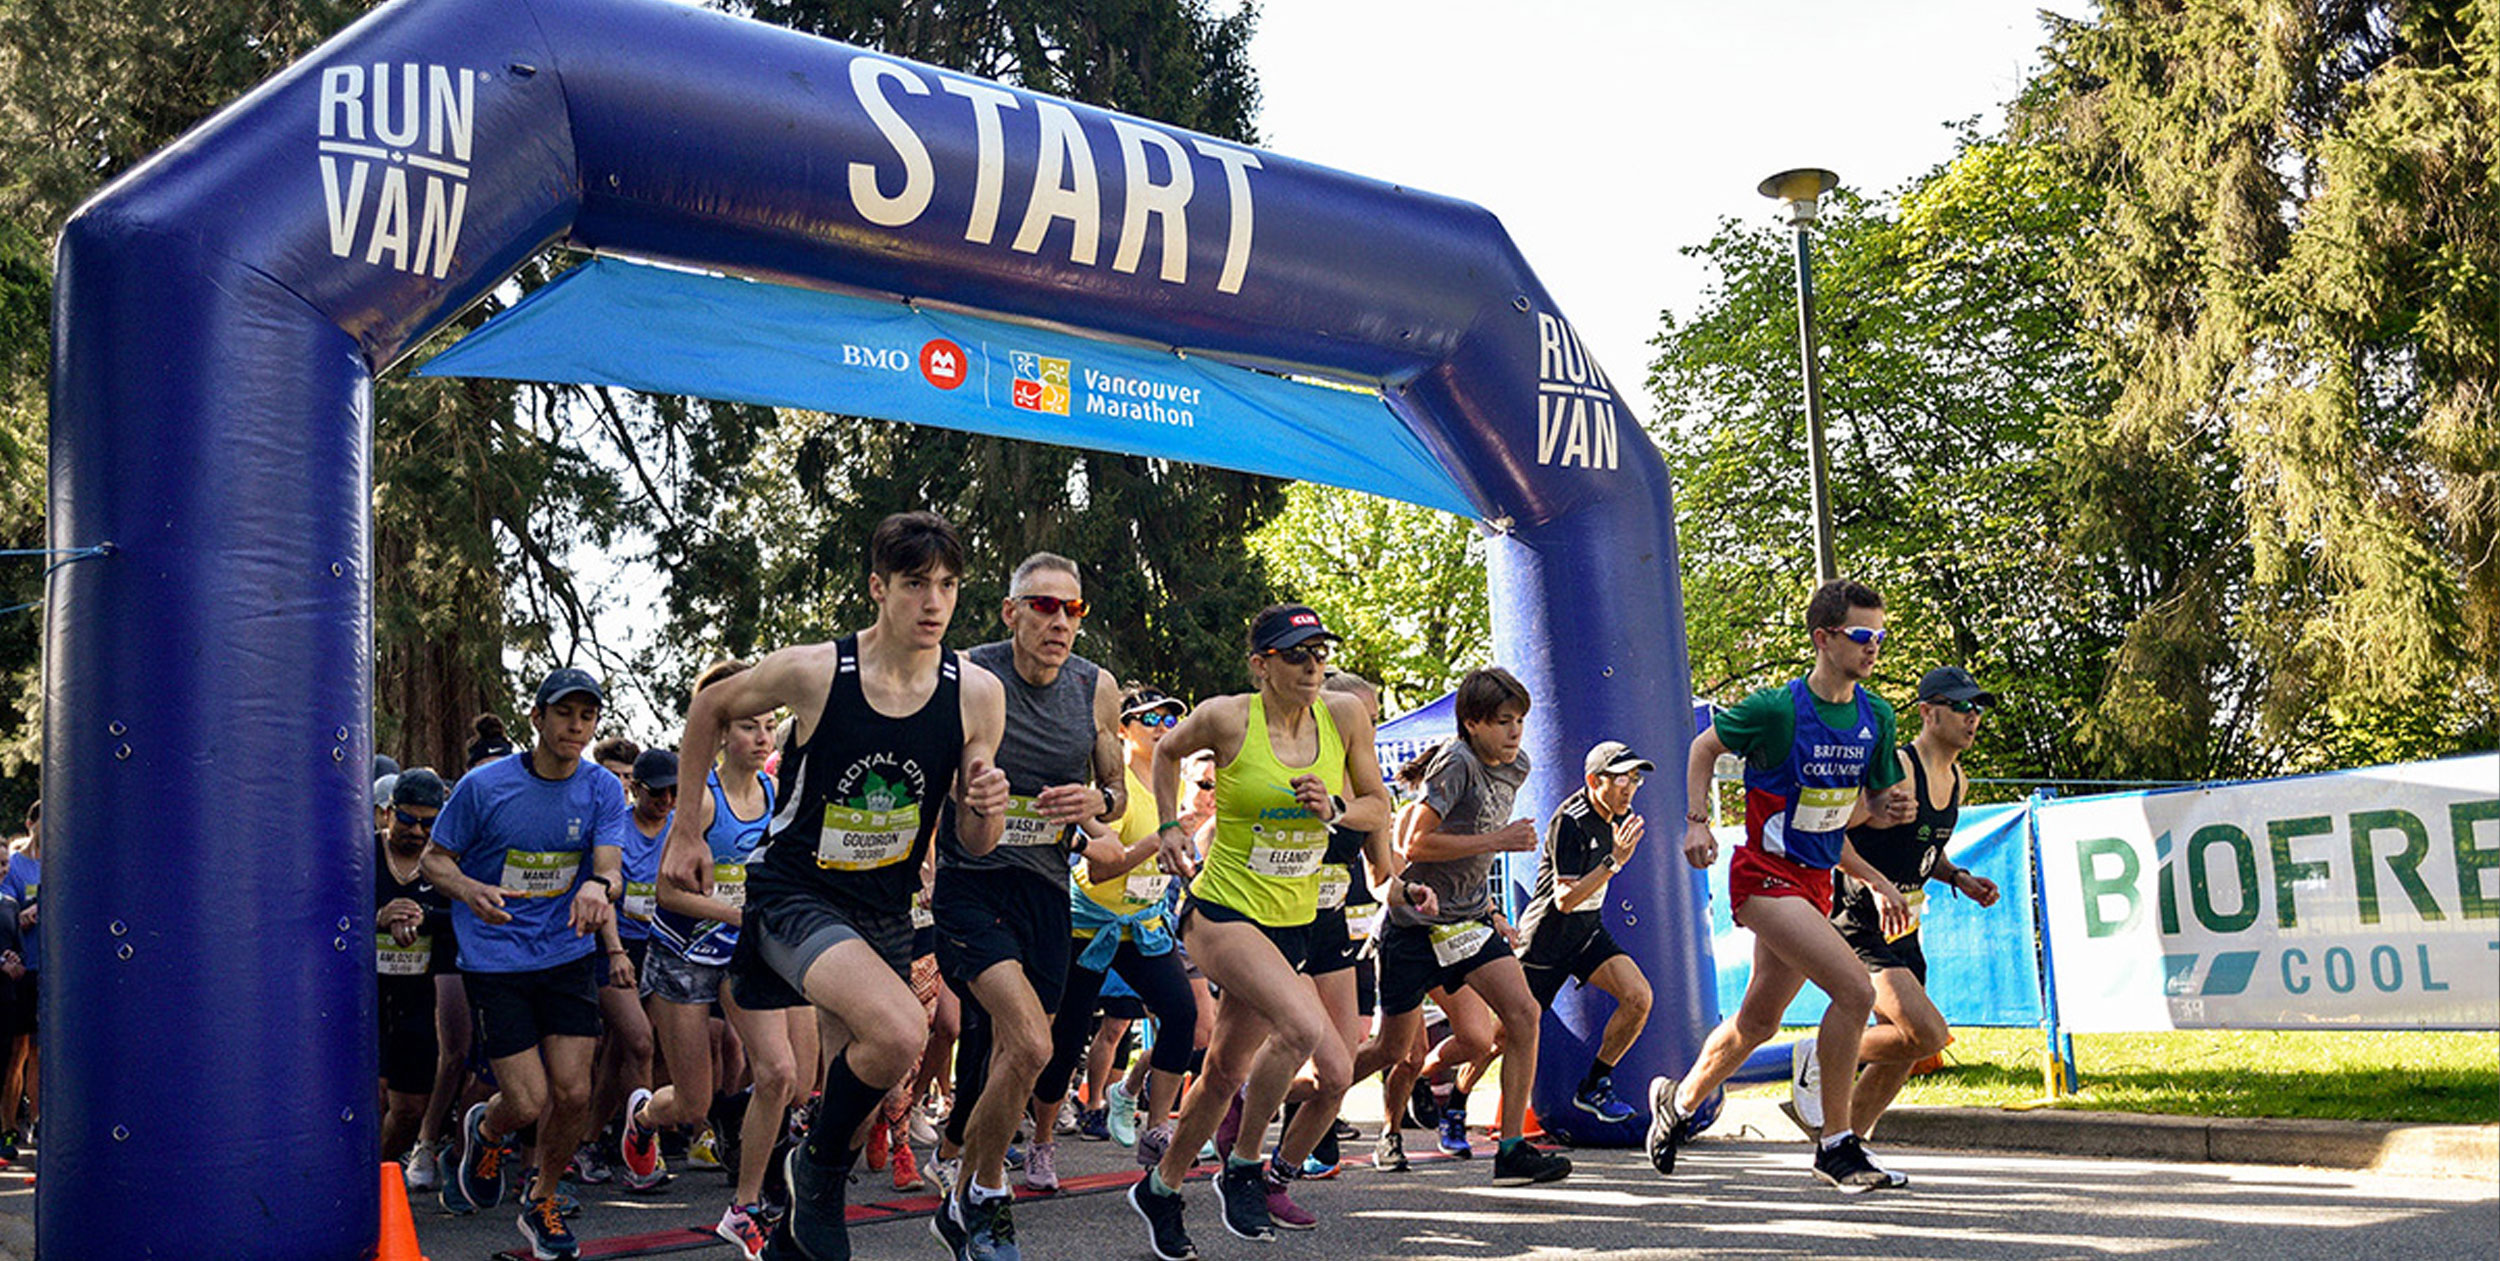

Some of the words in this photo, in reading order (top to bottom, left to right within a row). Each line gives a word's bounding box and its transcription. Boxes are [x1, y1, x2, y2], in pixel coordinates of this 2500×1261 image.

[319, 62, 475, 162] RUN
[848, 56, 1263, 294] START
[319, 155, 467, 280] VAN
[842, 344, 910, 372] BMO
[1084, 368, 1200, 405] Vancouver
[1086, 393, 1194, 428] Marathon
[1538, 394, 1618, 470] VAN
[1813, 744, 1865, 759] BRITISH
[837, 752, 898, 795] ROYAL
[902, 759, 926, 796] CITY
[842, 832, 901, 849] GOUDRON
[2281, 943, 2449, 994] COOL
